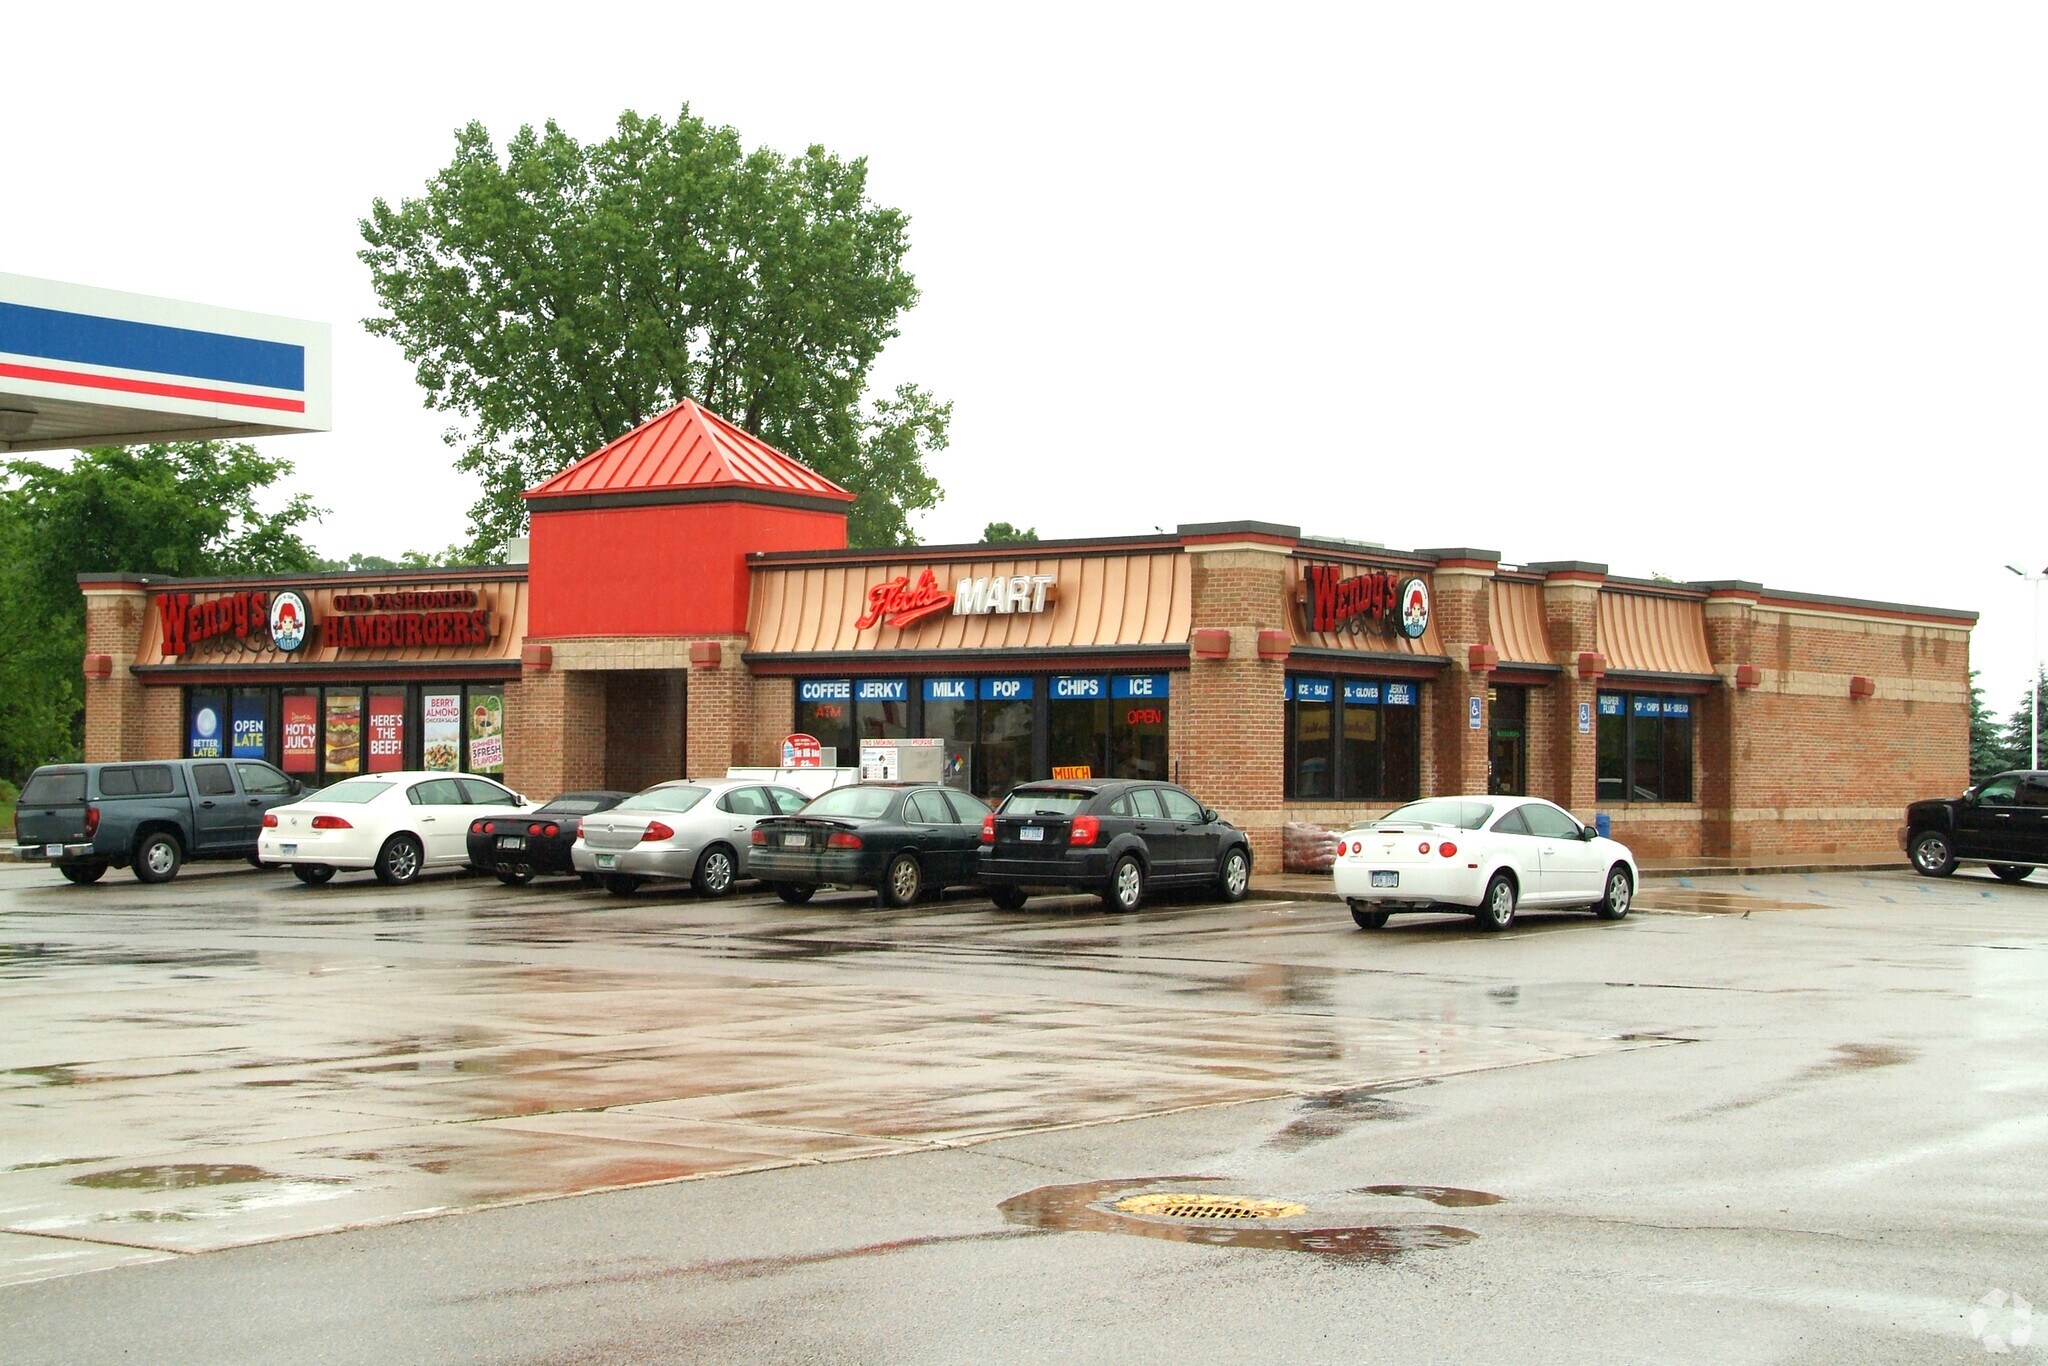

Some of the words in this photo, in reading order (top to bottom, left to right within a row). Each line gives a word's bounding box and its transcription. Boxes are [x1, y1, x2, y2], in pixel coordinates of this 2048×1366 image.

[333, 595, 371, 611] OLD
[373, 590, 477, 610] FASHIONED
[953, 575, 1053, 615] MART
[322, 610, 487, 647] HAMBURGERS
[803, 683, 850, 698] COFFEE
[859, 682, 903, 698] JERKY
[933, 682, 965, 697] MILK
[993, 681, 1020, 697] POP
[1058, 679, 1098, 696] CHIPS
[1129, 679, 1152, 695] ICE
[1299, 684, 1308, 695] ICE
[1314, 685, 1329, 695] SALT
[1356, 687, 1378, 698] GLOVES
[1389, 684, 1408, 694] JERKY
[431, 698, 455, 707] BERRY
[1388, 694, 1409, 705] CHEESE
[426, 708, 459, 717] ALMOND
[815, 704, 843, 718] ATM
[1126, 708, 1162, 725] OPEN
[234, 720, 263, 732] OPEN
[370, 714, 402, 727] HERE'S
[285, 723, 305, 735] HOT
[376, 727, 396, 739] THE
[193, 739, 219, 747] BETTER.
[234, 733, 263, 747] LATE
[284, 736, 316, 749] JUICY
[193, 748, 219, 757] LATER.
[370, 740, 402, 755] BEEF!
[478, 745, 501, 757] FRESH
[473, 754, 502, 766] FLAVORS
[1054, 767, 1089, 779] MULCH
